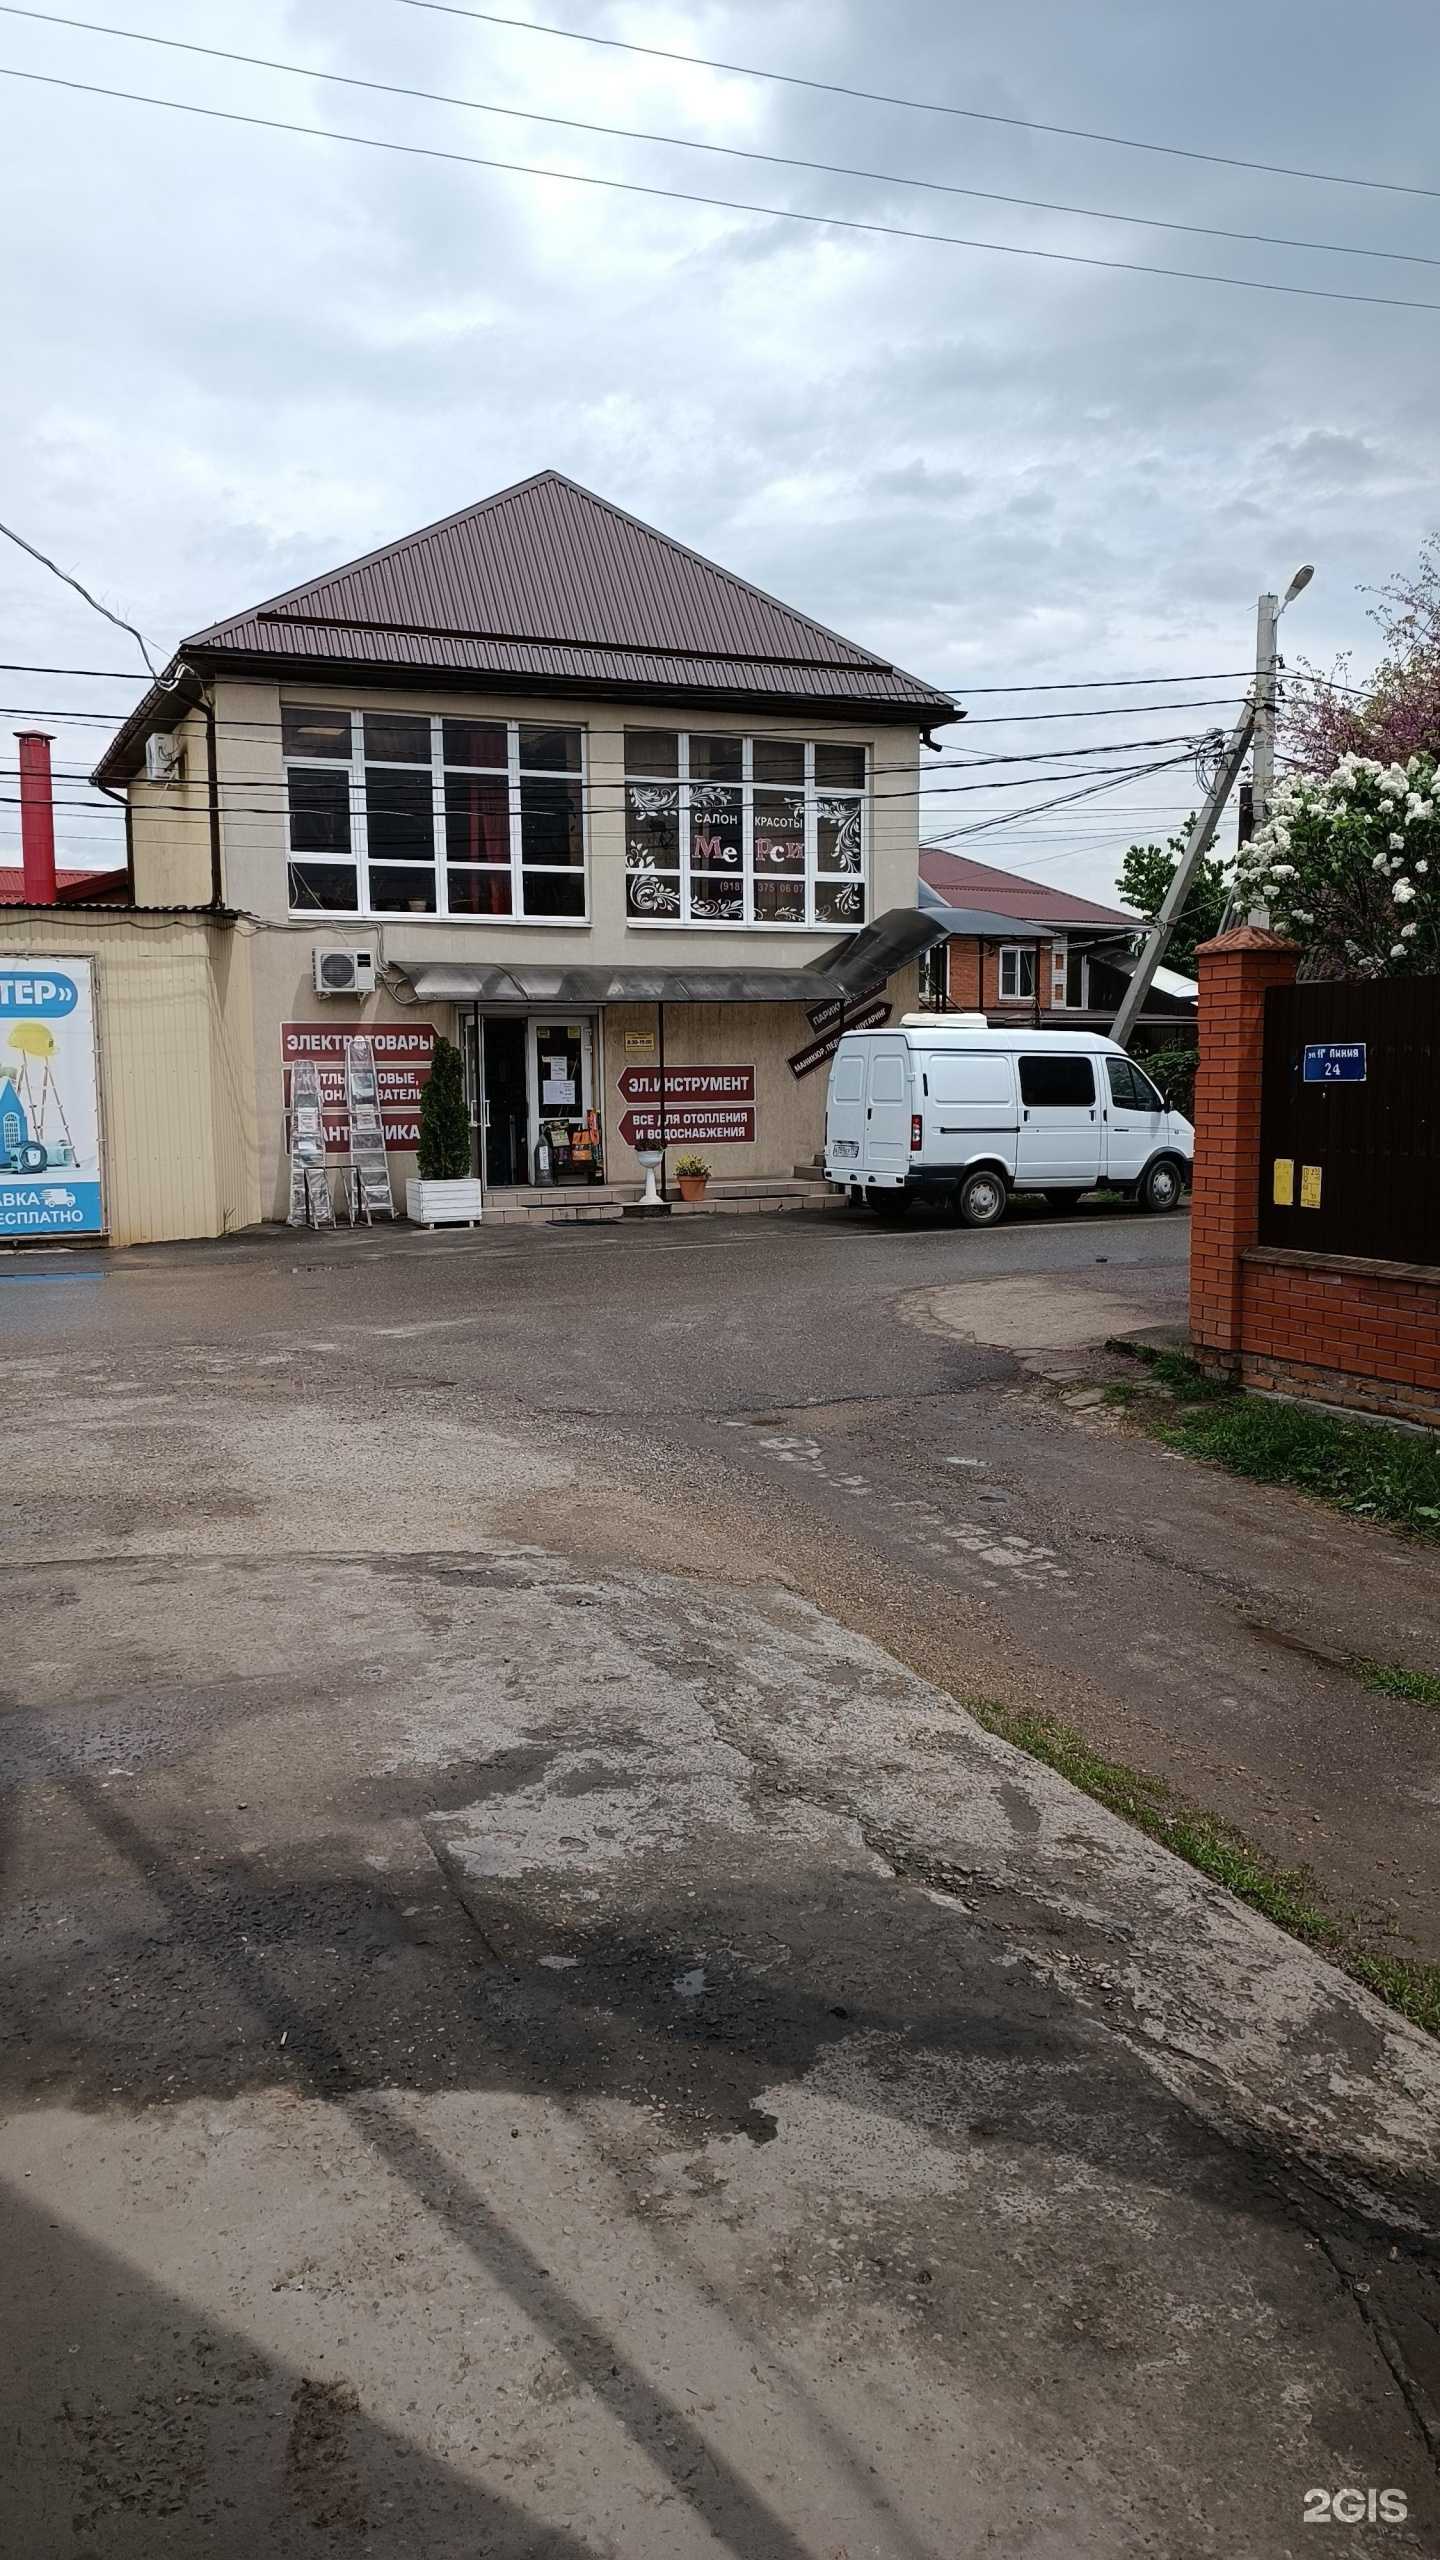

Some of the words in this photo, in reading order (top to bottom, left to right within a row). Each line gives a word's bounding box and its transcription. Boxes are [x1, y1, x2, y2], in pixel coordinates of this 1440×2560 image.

[694, 813, 738, 825] САЛОН
[754, 816, 803, 829] КРАСОТЫ
[1324, 1062, 1341, 1076] 24
[632, 1115, 654, 1125] ВСЕ
[683, 1112, 748, 1124] ОТОПЛЕНИЯ
[635, 1129, 644, 1140] И
[647, 1126, 745, 1141] ВОДОСНАБЖЕНИЯ
